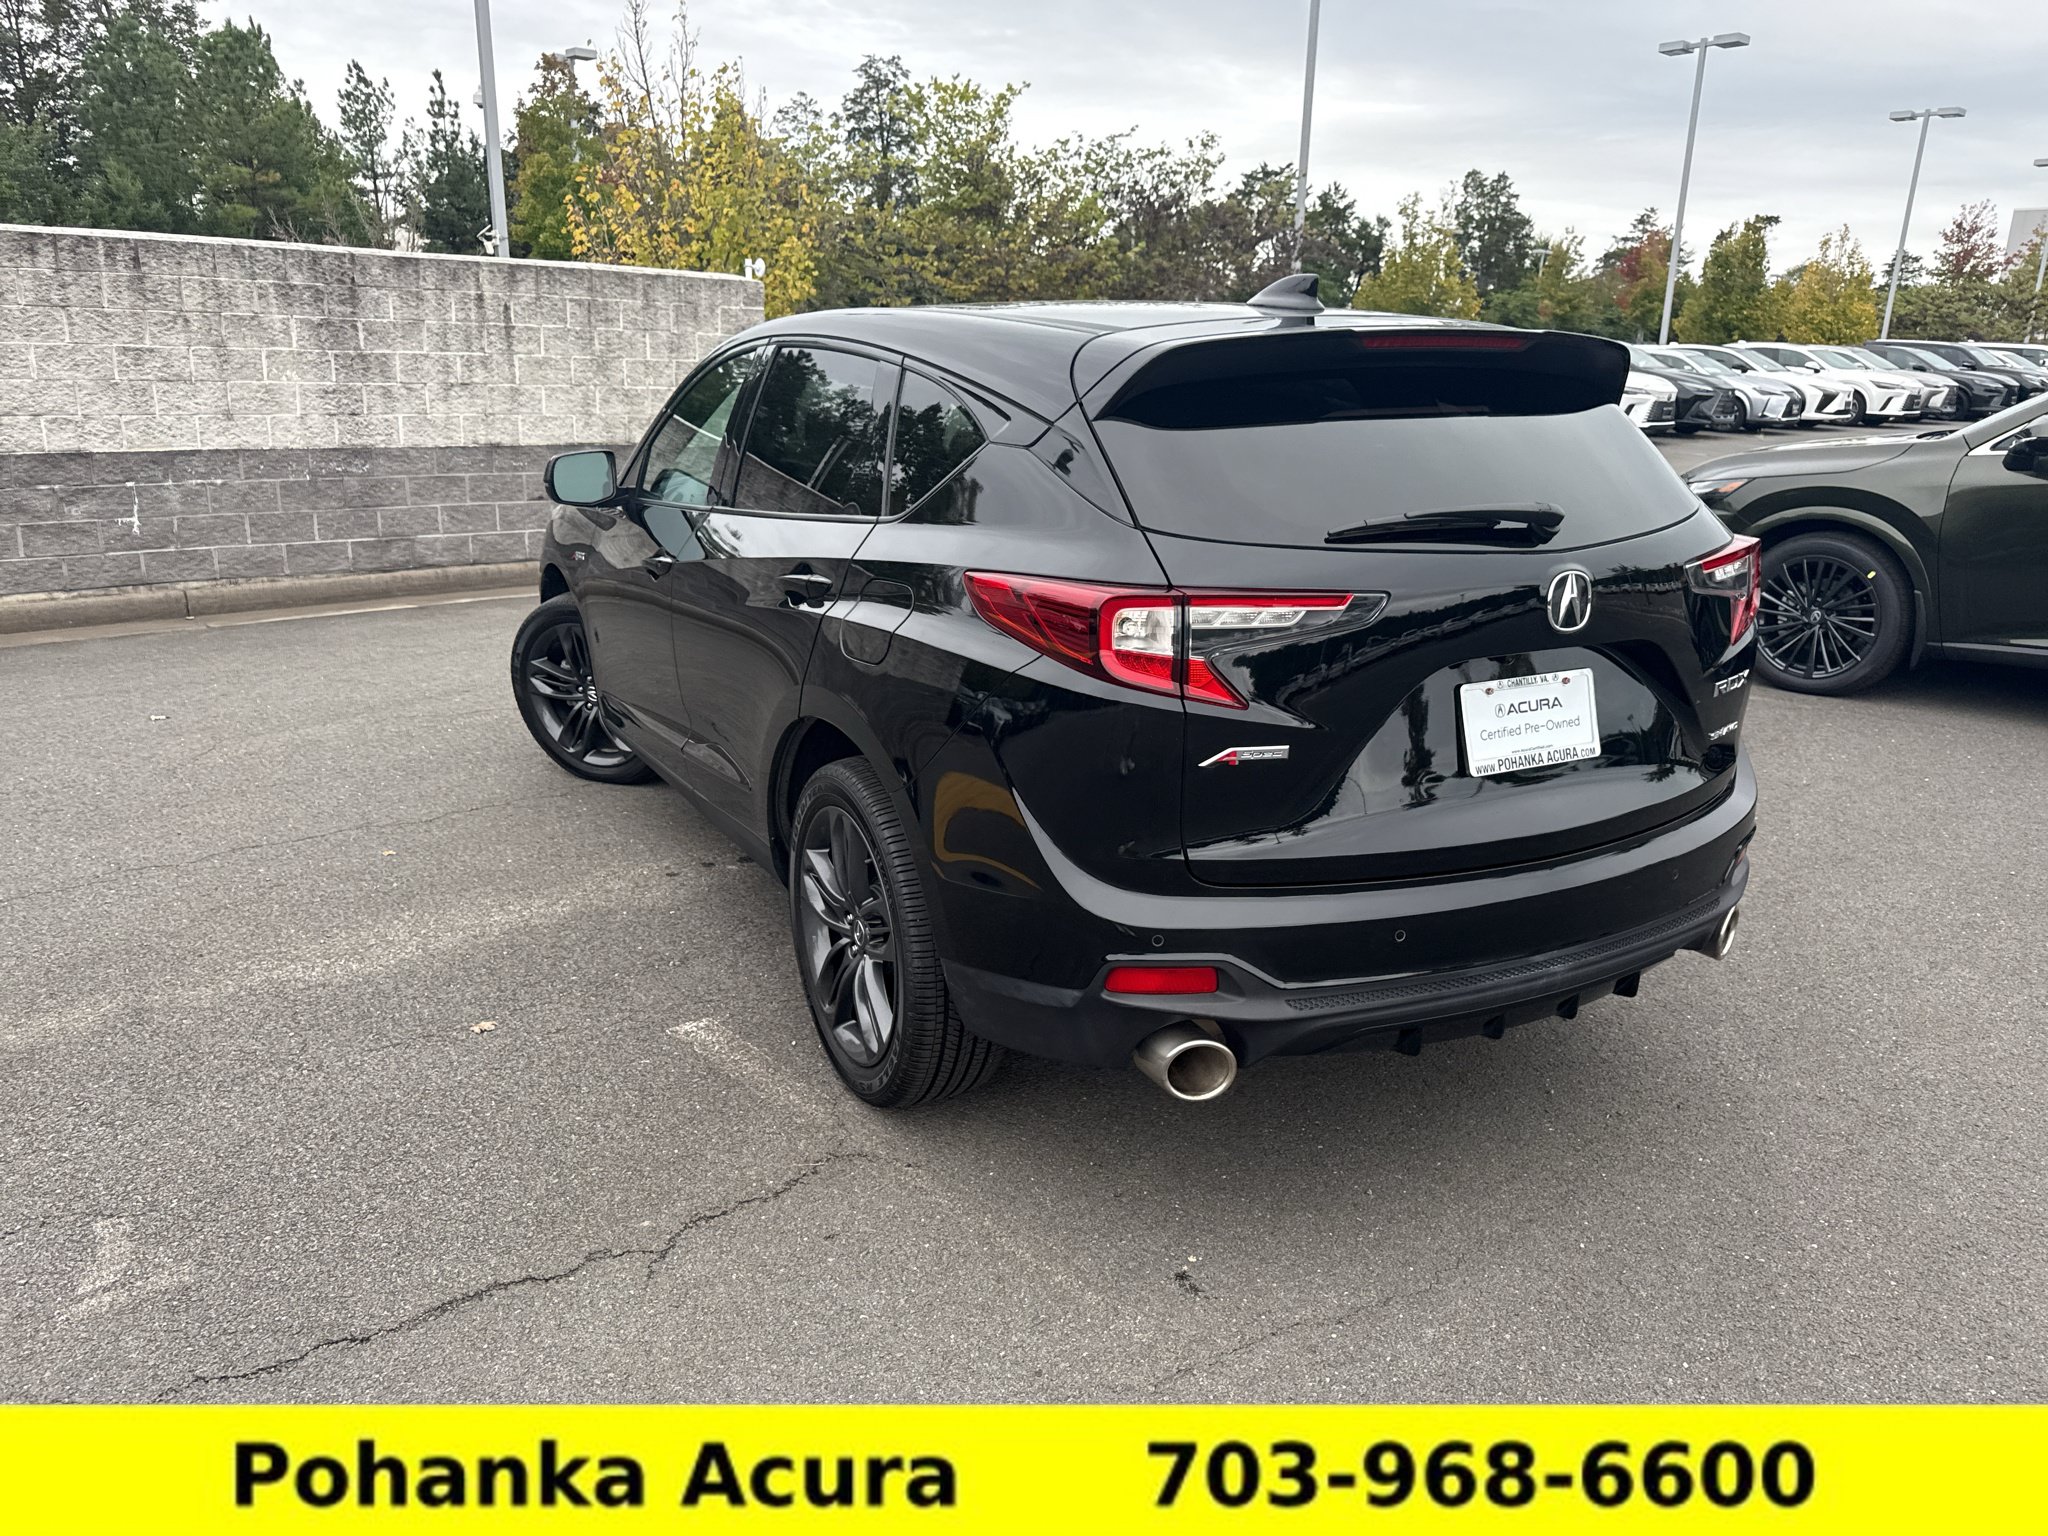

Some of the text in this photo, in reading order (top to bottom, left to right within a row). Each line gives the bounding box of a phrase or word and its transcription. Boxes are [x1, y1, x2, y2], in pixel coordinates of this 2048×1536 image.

[1507, 696, 1563, 716] ACURA
[1480, 715, 1581, 741] Certified Pre-Owned
